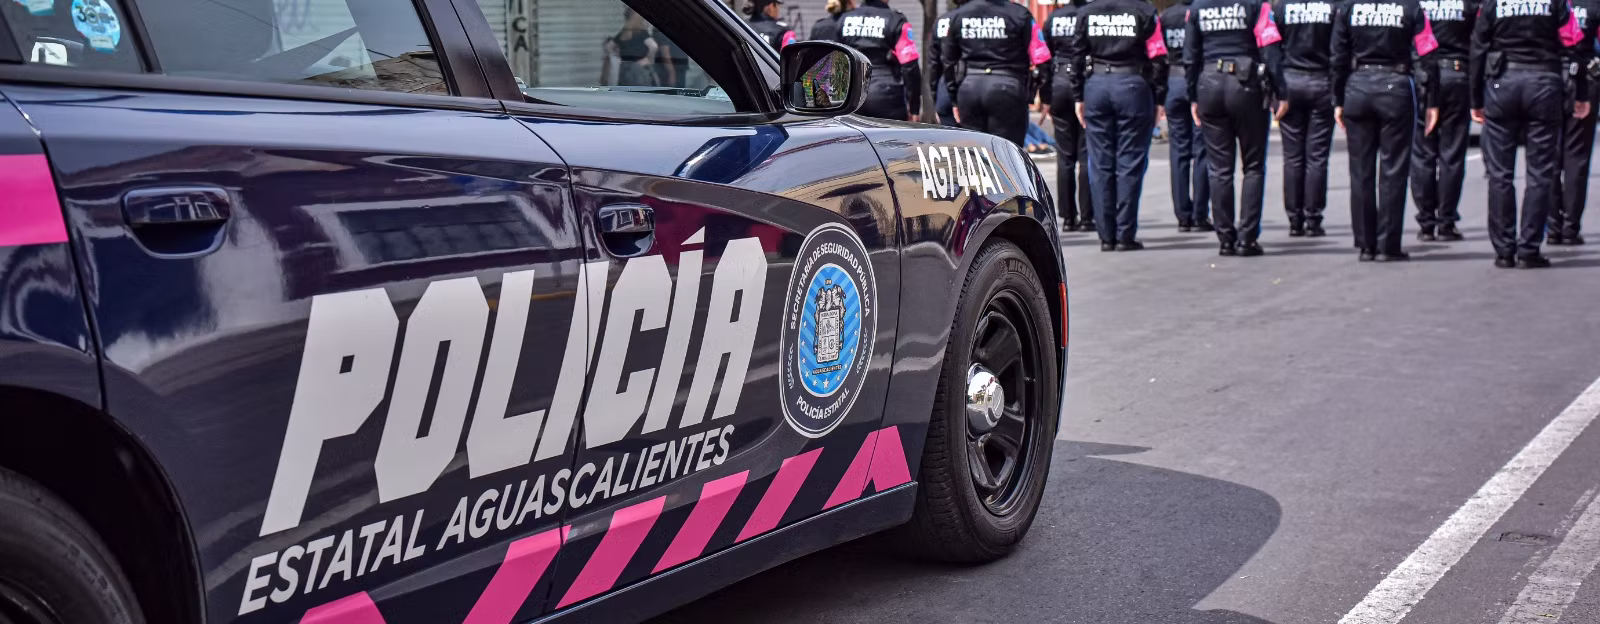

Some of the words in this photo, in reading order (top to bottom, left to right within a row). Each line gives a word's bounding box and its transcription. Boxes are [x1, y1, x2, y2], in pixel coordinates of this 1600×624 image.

[1199, 3, 1247, 20] POLICÍA
[1496, 5, 1552, 18] ESTATAL
[961, 16, 1006, 28] POLICÍA
[1088, 13, 1136, 26] POLICÍA
[1200, 18, 1248, 32] ESTATAL
[1351, 14, 1404, 28] ESTATAL
[842, 26, 885, 38] ESTATAL
[961, 28, 1008, 39] ESTATAL
[1088, 26, 1136, 37] ESTATAL
[916, 145, 1005, 199] AG744A1
[790, 256, 815, 330] SECRETARÍA
[812, 246, 822, 262] DE
[820, 242, 859, 269] SEGURIDAD
[856, 265, 871, 318] PÚBLICA
[259, 226, 767, 537] POLICÍA
[796, 395, 824, 420] POLICÍA
[823, 387, 850, 419] ESTATAL
[237, 514, 429, 616] ESTATAL
[436, 423, 735, 551] AGUASCALIENTES
